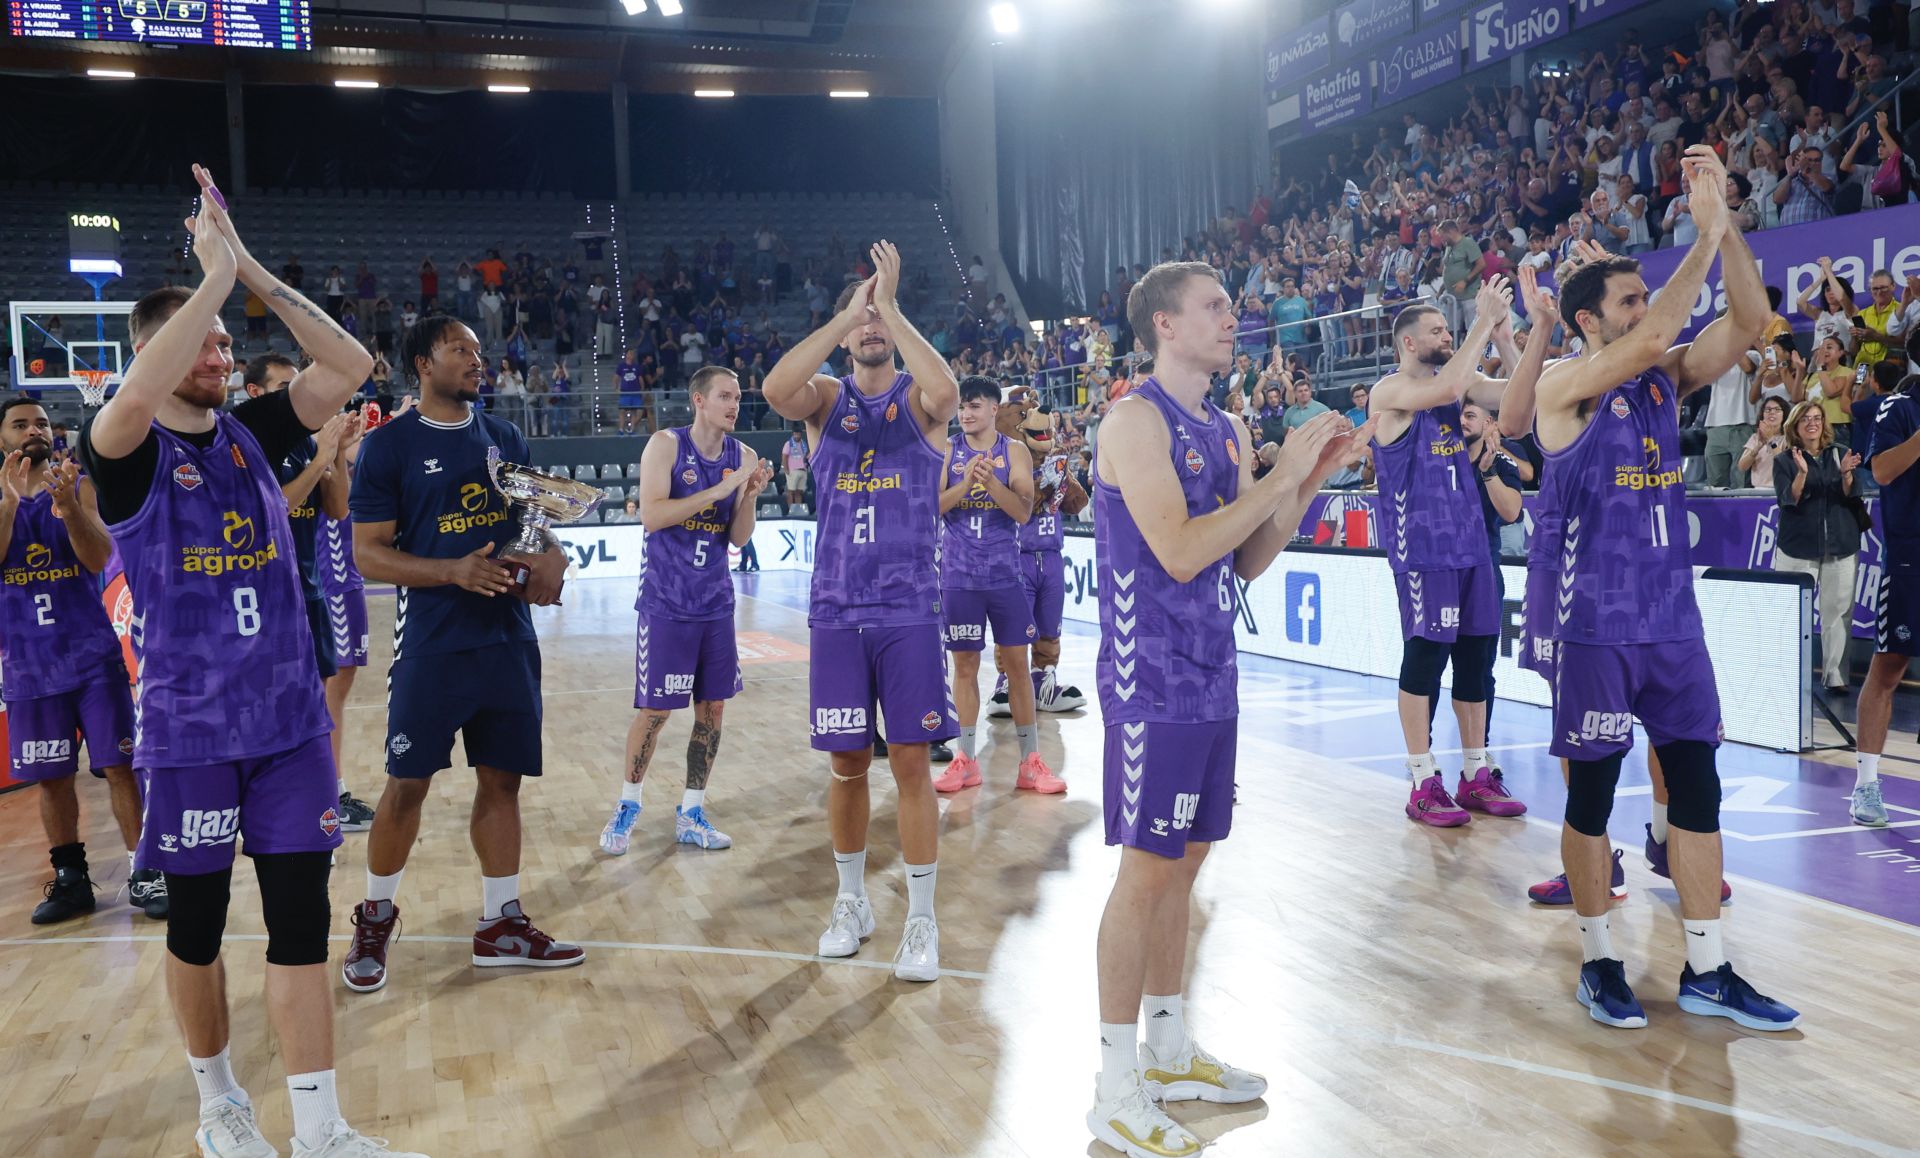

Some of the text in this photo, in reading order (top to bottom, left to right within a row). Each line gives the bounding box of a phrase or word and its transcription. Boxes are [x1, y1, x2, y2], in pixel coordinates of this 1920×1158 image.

[136, 1, 147, 15] 5
[178, 4, 189, 18] 5
[231, 31, 263, 39] JACKSON
[232, 40, 264, 48] SAMUELS
[1403, 31, 1457, 71] GABAN
[1411, 55, 1454, 80] MODA HOMBRE
[1306, 68, 1361, 107] Peñafría
[71, 214, 111, 227] 10:00
[1447, 465, 1456, 491] 7
[1615, 464, 1643, 473] súper
[437, 511, 463, 521] súper
[438, 507, 508, 534] agropal
[853, 505, 876, 544] 21
[970, 516, 982, 538] 4
[1038, 516, 1055, 535] 23
[182, 545, 222, 556] súper
[693, 539, 709, 567] 5
[4, 564, 79, 585] agropal
[1217, 565, 1232, 611] 6
[34, 593, 55, 626] 2
[233, 587, 260, 636] 8
[950, 623, 982, 641] gaza
[665, 674, 695, 695] gaza
[816, 707, 867, 735] gaza
[22, 739, 70, 765] gaza
